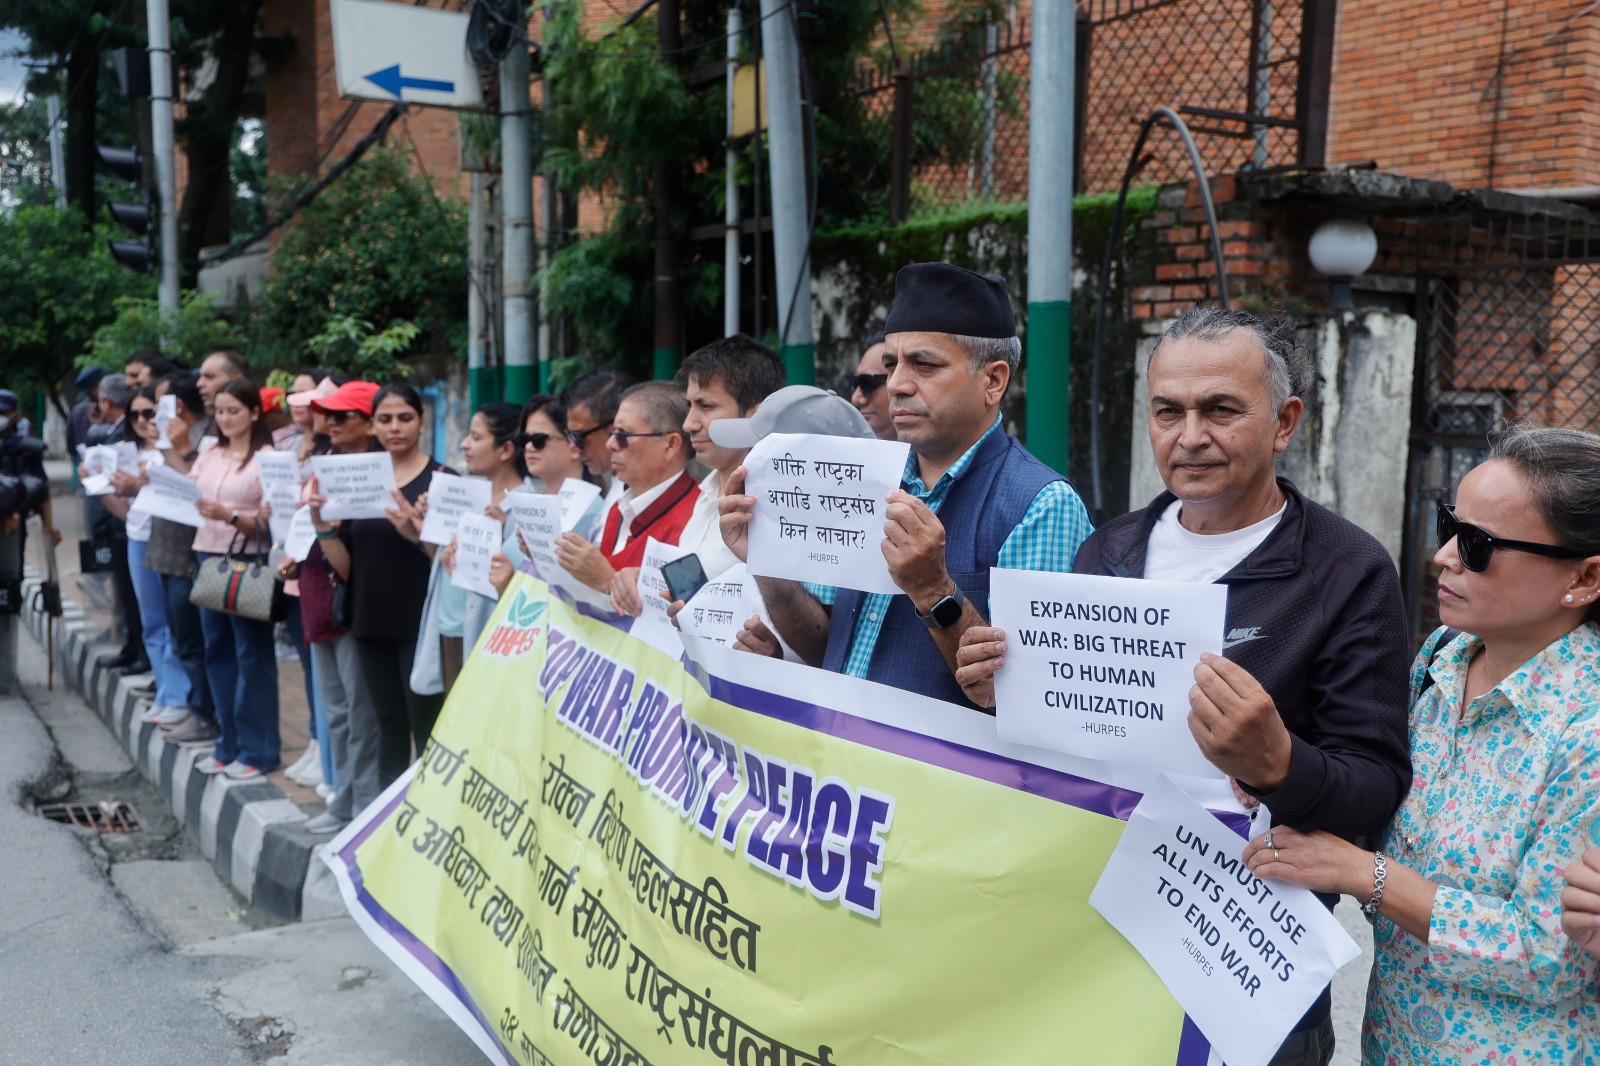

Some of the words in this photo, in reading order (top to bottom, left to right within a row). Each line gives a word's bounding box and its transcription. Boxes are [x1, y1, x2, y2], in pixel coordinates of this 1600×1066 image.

[771, 452, 806, 477] शक्ति
[814, 461, 865, 486] राष्ट्रका
[768, 486, 811, 510] अगाडि
[818, 494, 876, 519] राष्ट्रसंघ
[779, 516, 808, 541] किन
[816, 526, 866, 549] लाचार?
[807, 552, 839, 565] -HURPES
[693, 607, 705, 627] युद्ध
[707, 609, 734, 626] तत्काल
[1030, 600, 1138, 625] EXPANSION
[1143, 608, 1170, 627] OF
[1018, 629, 1069, 650] WAR:
[1073, 633, 1105, 653] BIG
[1110, 636, 1187, 660] THREAT
[1225, 626, 1262, 640] NIKE
[1048, 661, 1074, 680] TO
[1079, 664, 1156, 689] HUMAN
[1044, 690, 1164, 722] CIVILIZATION
[1081, 721, 1127, 738] -HURPES
[540, 627, 588, 704] TOP
[722, 751, 890, 912] PEACE
[1174, 824, 1210, 857] UN
[1212, 850, 1273, 905] MUST
[1269, 900, 1307, 946] USE
[481, 884, 525, 948] तथा
[1152, 843, 1188, 878] ALL
[1192, 872, 1225, 903] ITS
[1221, 897, 1295, 983] EFFORTS
[1156, 876, 1184, 908] TO
[1183, 903, 1222, 948] END
[1219, 942, 1262, 998] WAR
[1180, 936, 1215, 977] -HURPES
